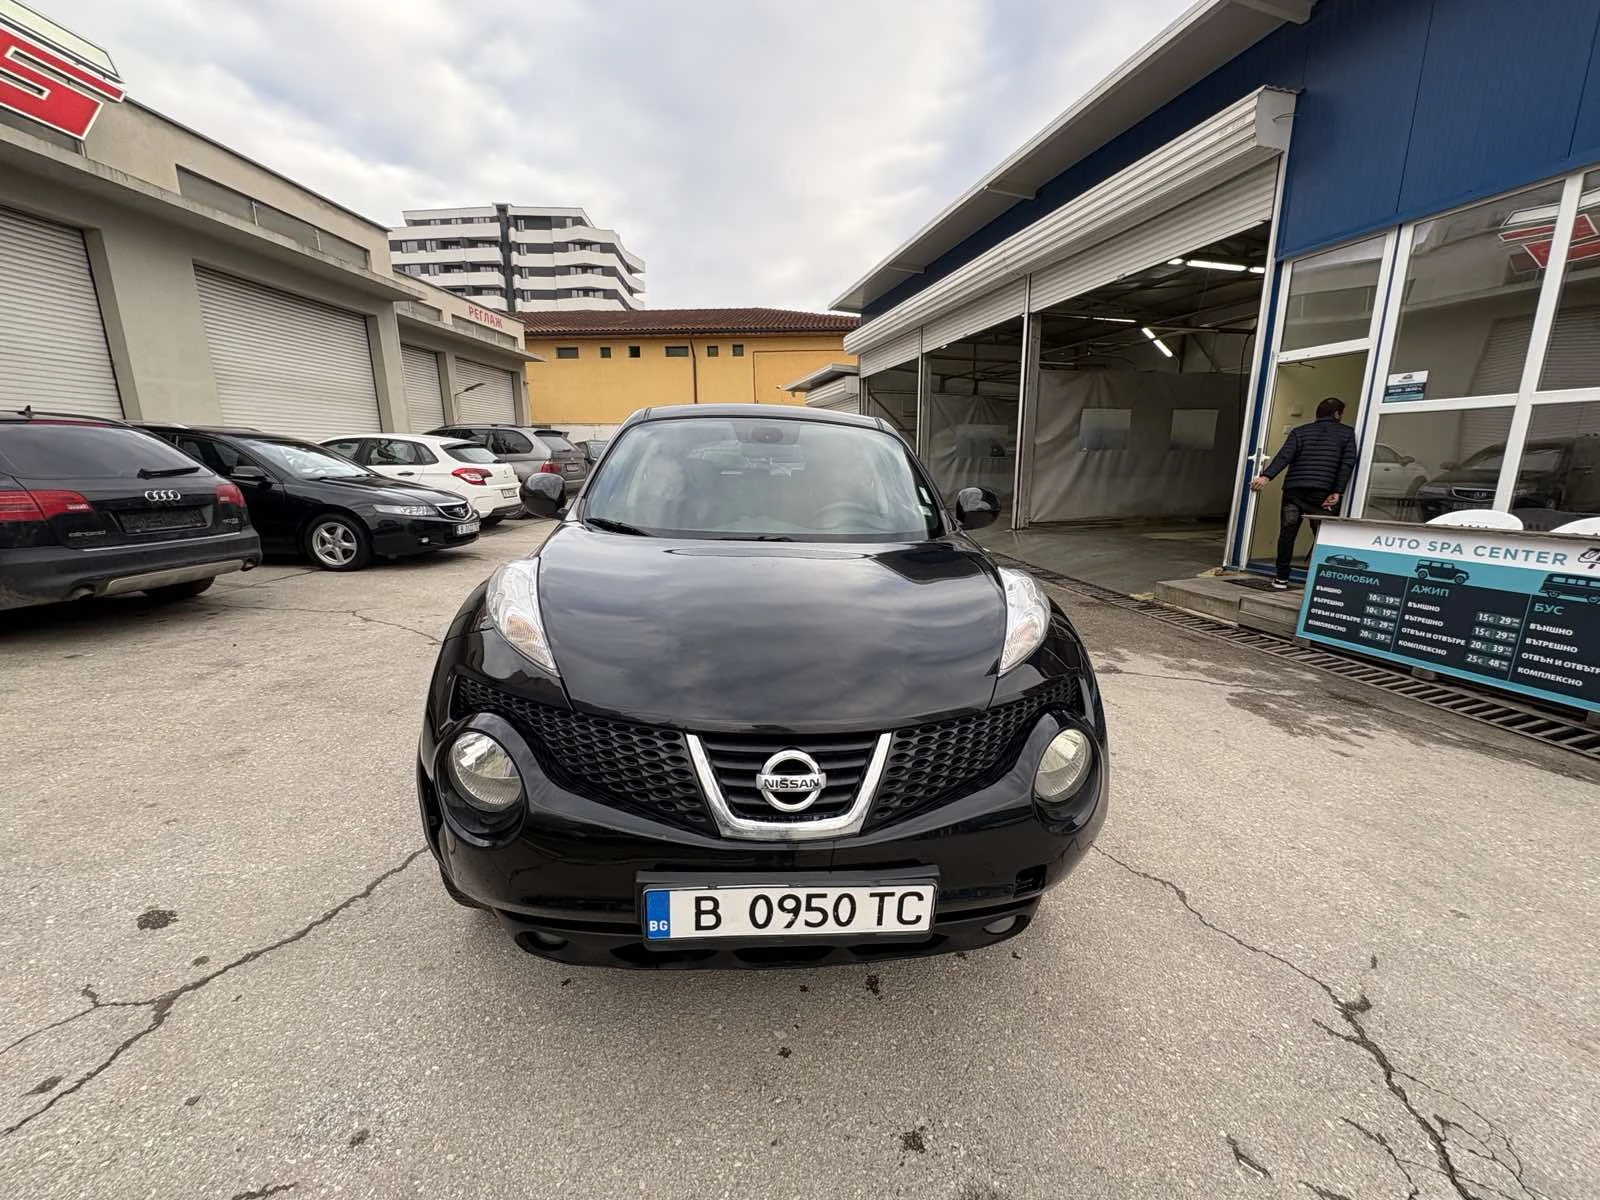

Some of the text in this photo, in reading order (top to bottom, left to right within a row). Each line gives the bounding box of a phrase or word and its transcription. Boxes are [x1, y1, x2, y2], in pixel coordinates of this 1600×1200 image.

[468, 304, 503, 328] РЕГЛАЖ
[1371, 535, 1568, 566] AUTO SPA CENTER
[1320, 570, 1380, 585] АВТОМОБИЛ
[1411, 584, 1449, 597] ДЖИП
[1408, 601, 1440, 612] ВЪНШНО
[1534, 603, 1565, 615] БУС
[1404, 614, 1444, 627] ВЪТРЕШНО
[1401, 627, 1425, 637] ОТВЪН
[1432, 634, 1466, 646] ОТВЪТРЕ
[1529, 623, 1573, 636] ВЪНШНО
[1398, 640, 1447, 655] КОМПЛЕКСНО
[1525, 638, 1578, 653] ВЪТРЕШНО
[1521, 652, 1553, 665] ОТВЪН
[1517, 667, 1583, 687] КОМПЛЕКСНО
[763, 778, 820, 790] NISSAN
[694, 892, 925, 931] B 0950 TC
[649, 920, 668, 931] BG
